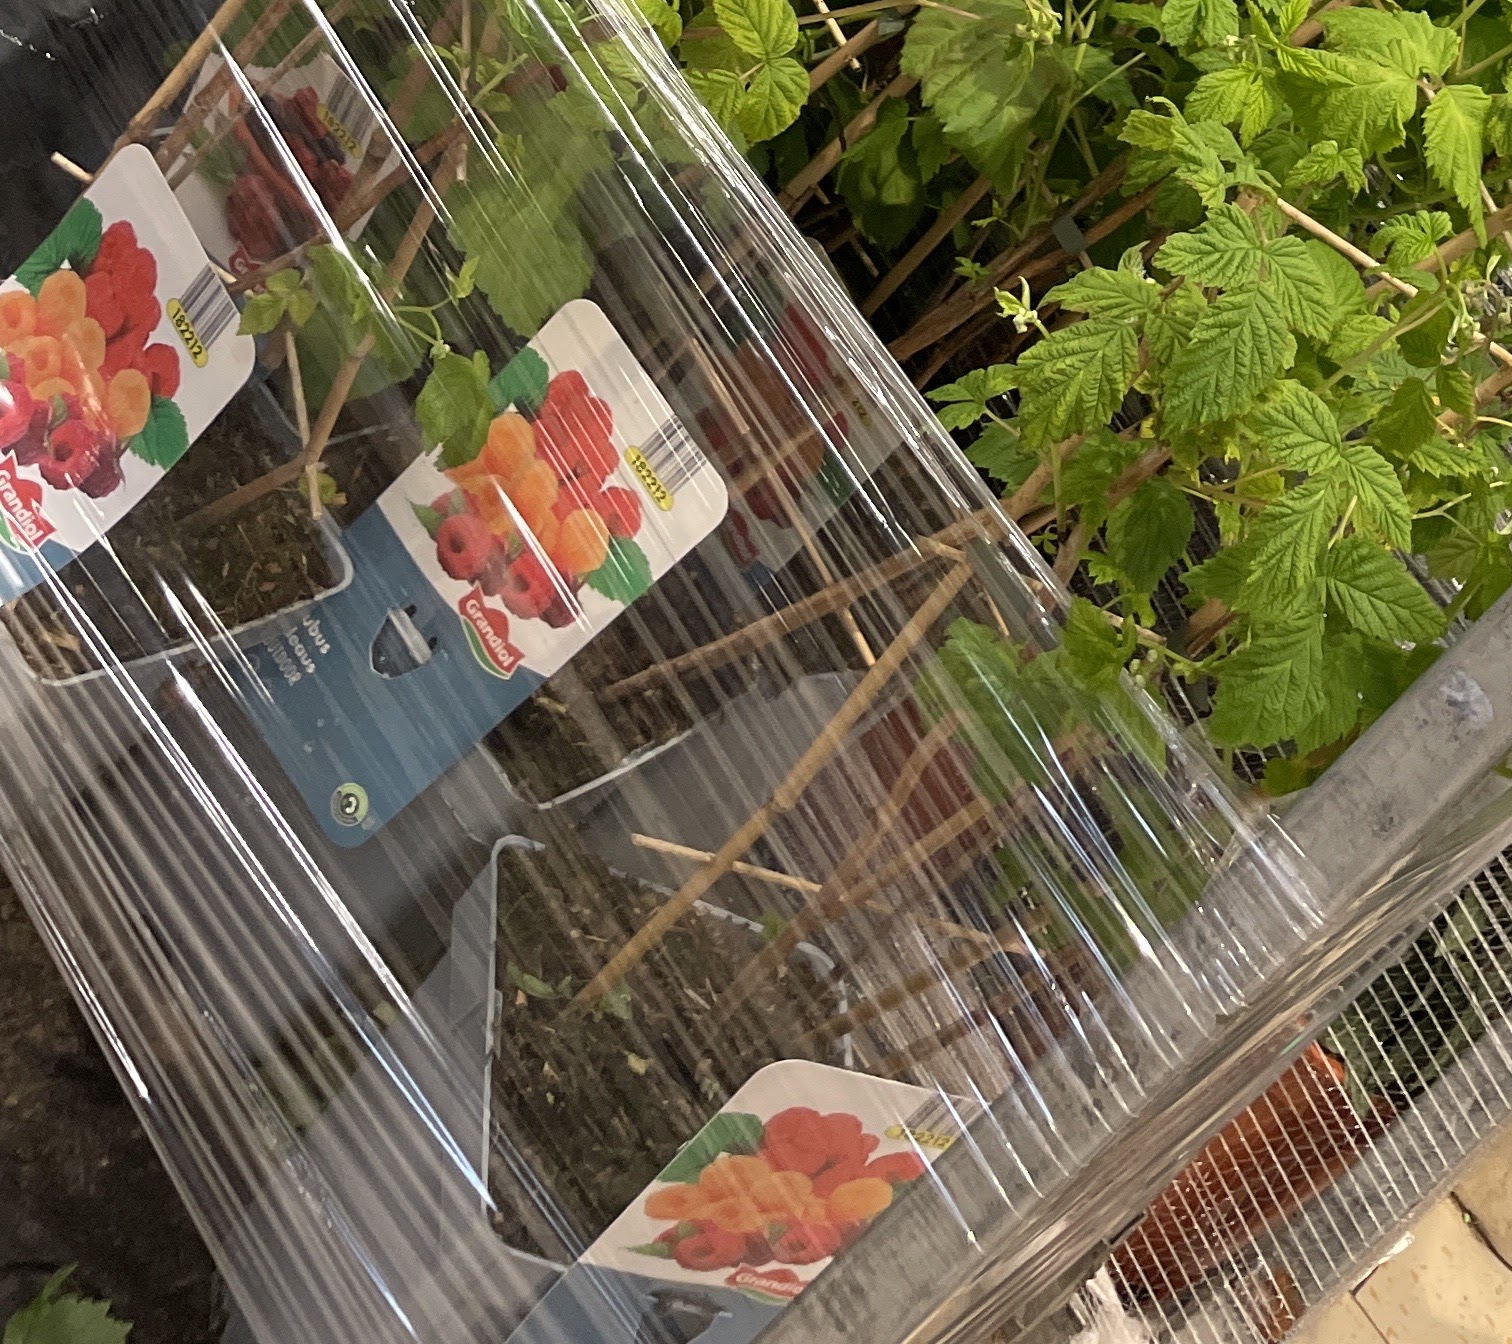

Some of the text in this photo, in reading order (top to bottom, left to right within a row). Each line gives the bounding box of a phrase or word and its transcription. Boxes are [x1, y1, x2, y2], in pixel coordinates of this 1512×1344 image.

[171, 306, 203, 360] 182212
[0, 469, 45, 543] Grandiol
[631, 454, 668, 505] 182212
[301, 614, 332, 655] ubus
[465, 598, 516, 669] Grandiol
